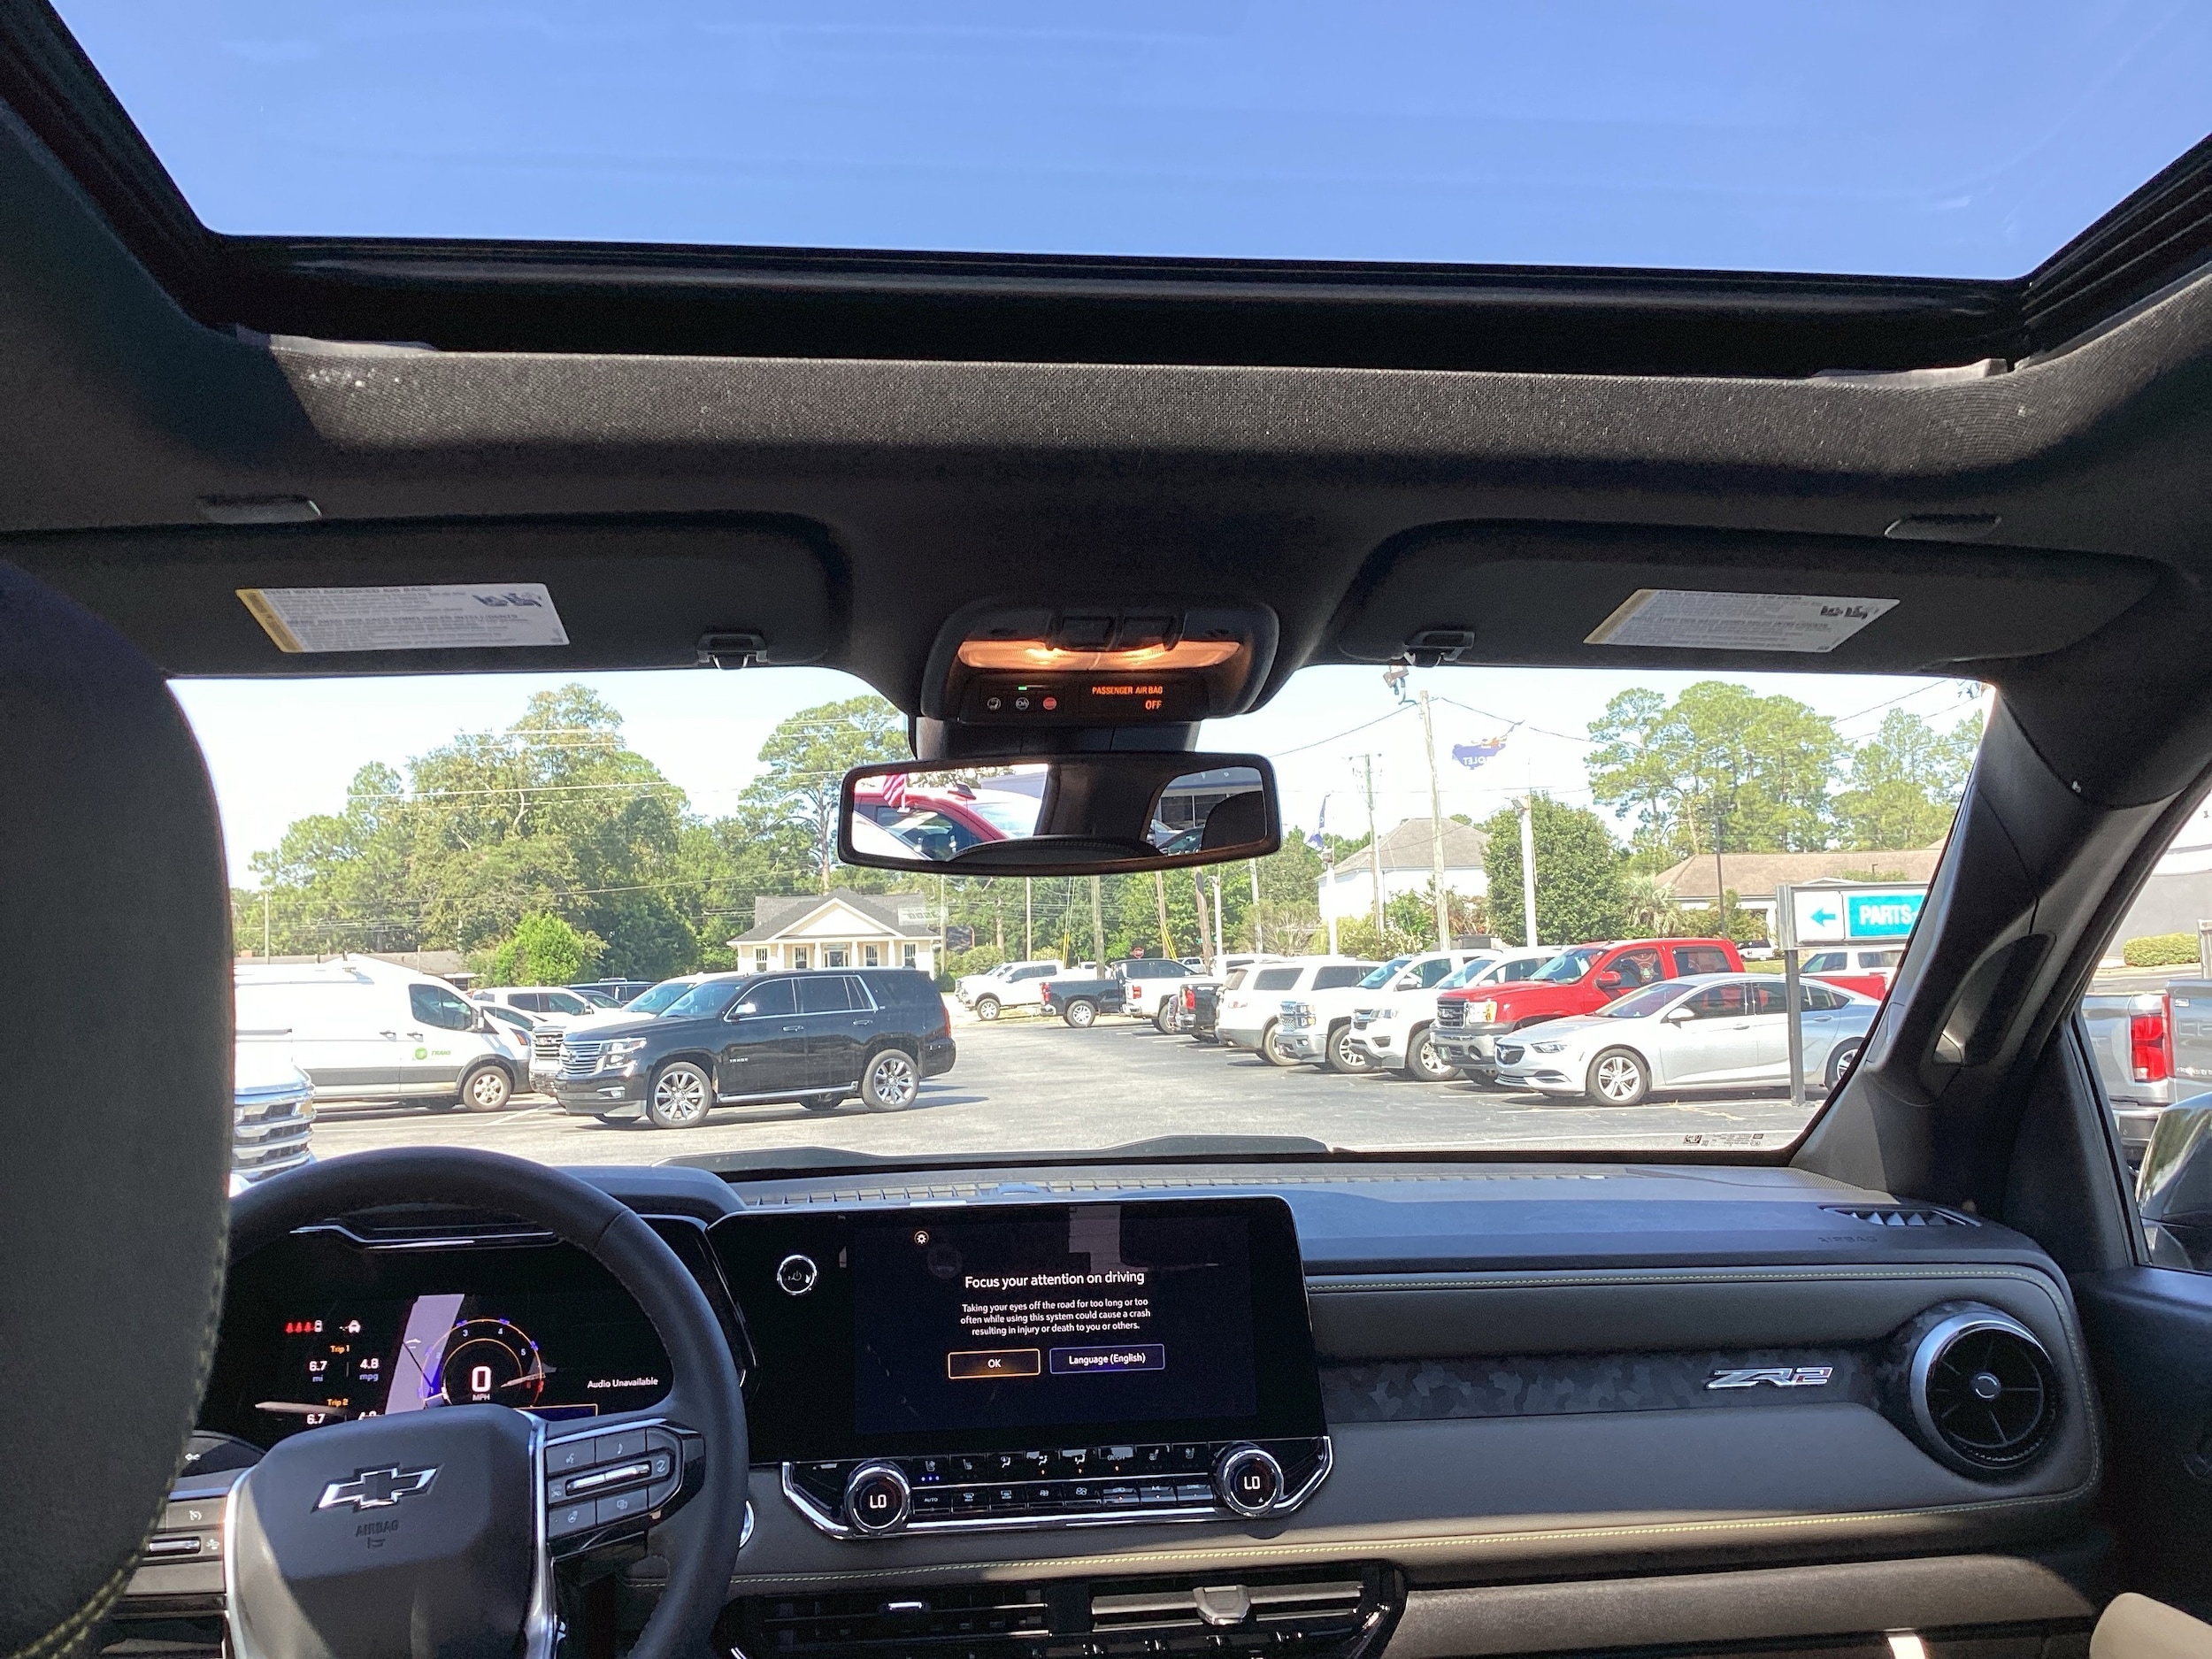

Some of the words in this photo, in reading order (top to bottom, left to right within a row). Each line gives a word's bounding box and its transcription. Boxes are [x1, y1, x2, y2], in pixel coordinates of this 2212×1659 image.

[1092, 686, 1133, 695] PASSENGER
[1134, 686, 1148, 695] AIR
[1145, 700, 1163, 710] OFF
[1859, 903, 1913, 926] PARTS
[964, 1276, 1000, 1289] Focus
[1002, 1277, 1028, 1291] your
[1030, 1273, 1085, 1286] attention
[1086, 1274, 1102, 1284] on
[1104, 1270, 1145, 1286] driving
[962, 1303, 988, 1314] Taking
[989, 1303, 1009, 1313] your
[1009, 1303, 1027, 1313] eyes
[1028, 1301, 1041, 1310] off
[1042, 1301, 1056, 1310] the
[1056, 1299, 1076, 1309] road
[1076, 1299, 1089, 1308] for
[1104, 1298, 1124, 1309] long
[960, 1315, 982, 1325] often
[983, 1314, 1005, 1324] while
[1006, 1314, 1028, 1325] using
[1029, 1313, 1045, 1322] this
[1046, 1311, 1074, 1323] system
[1074, 1310, 1097, 1320] could
[1129, 1309, 1151, 1317] crash
[972, 1326, 1007, 1337] resulting
[1017, 1325, 1040, 1336] injury
[1051, 1323, 1075, 1333] death
[1076, 1323, 1085, 1332] to
[1085, 1324, 1101, 1333] you
[1111, 1321, 1141, 1330] others.
[329, 1345, 345, 1355] Trip
[346, 1344, 350, 1353] 1
[520, 1347, 527, 1356] 5
[309, 1360, 327, 1371] 6.7
[359, 1357, 380, 1370] 4.8
[987, 1358, 1002, 1368] OK
[1068, 1355, 1109, 1367] Language
[1110, 1352, 1147, 1365] (English)
[359, 1373, 380, 1382] mpg
[471, 1365, 492, 1393] 0
[587, 1379, 611, 1388] Audio
[612, 1377, 659, 1387] Unavailable
[1707, 1366, 1834, 1390] ZR2
[327, 1398, 342, 1407] Trip
[306, 1413, 326, 1425] 6.7
[1244, 1476, 1261, 1490] LO
[870, 1494, 887, 1509] LO
[355, 1519, 399, 1537] AIRBAG
